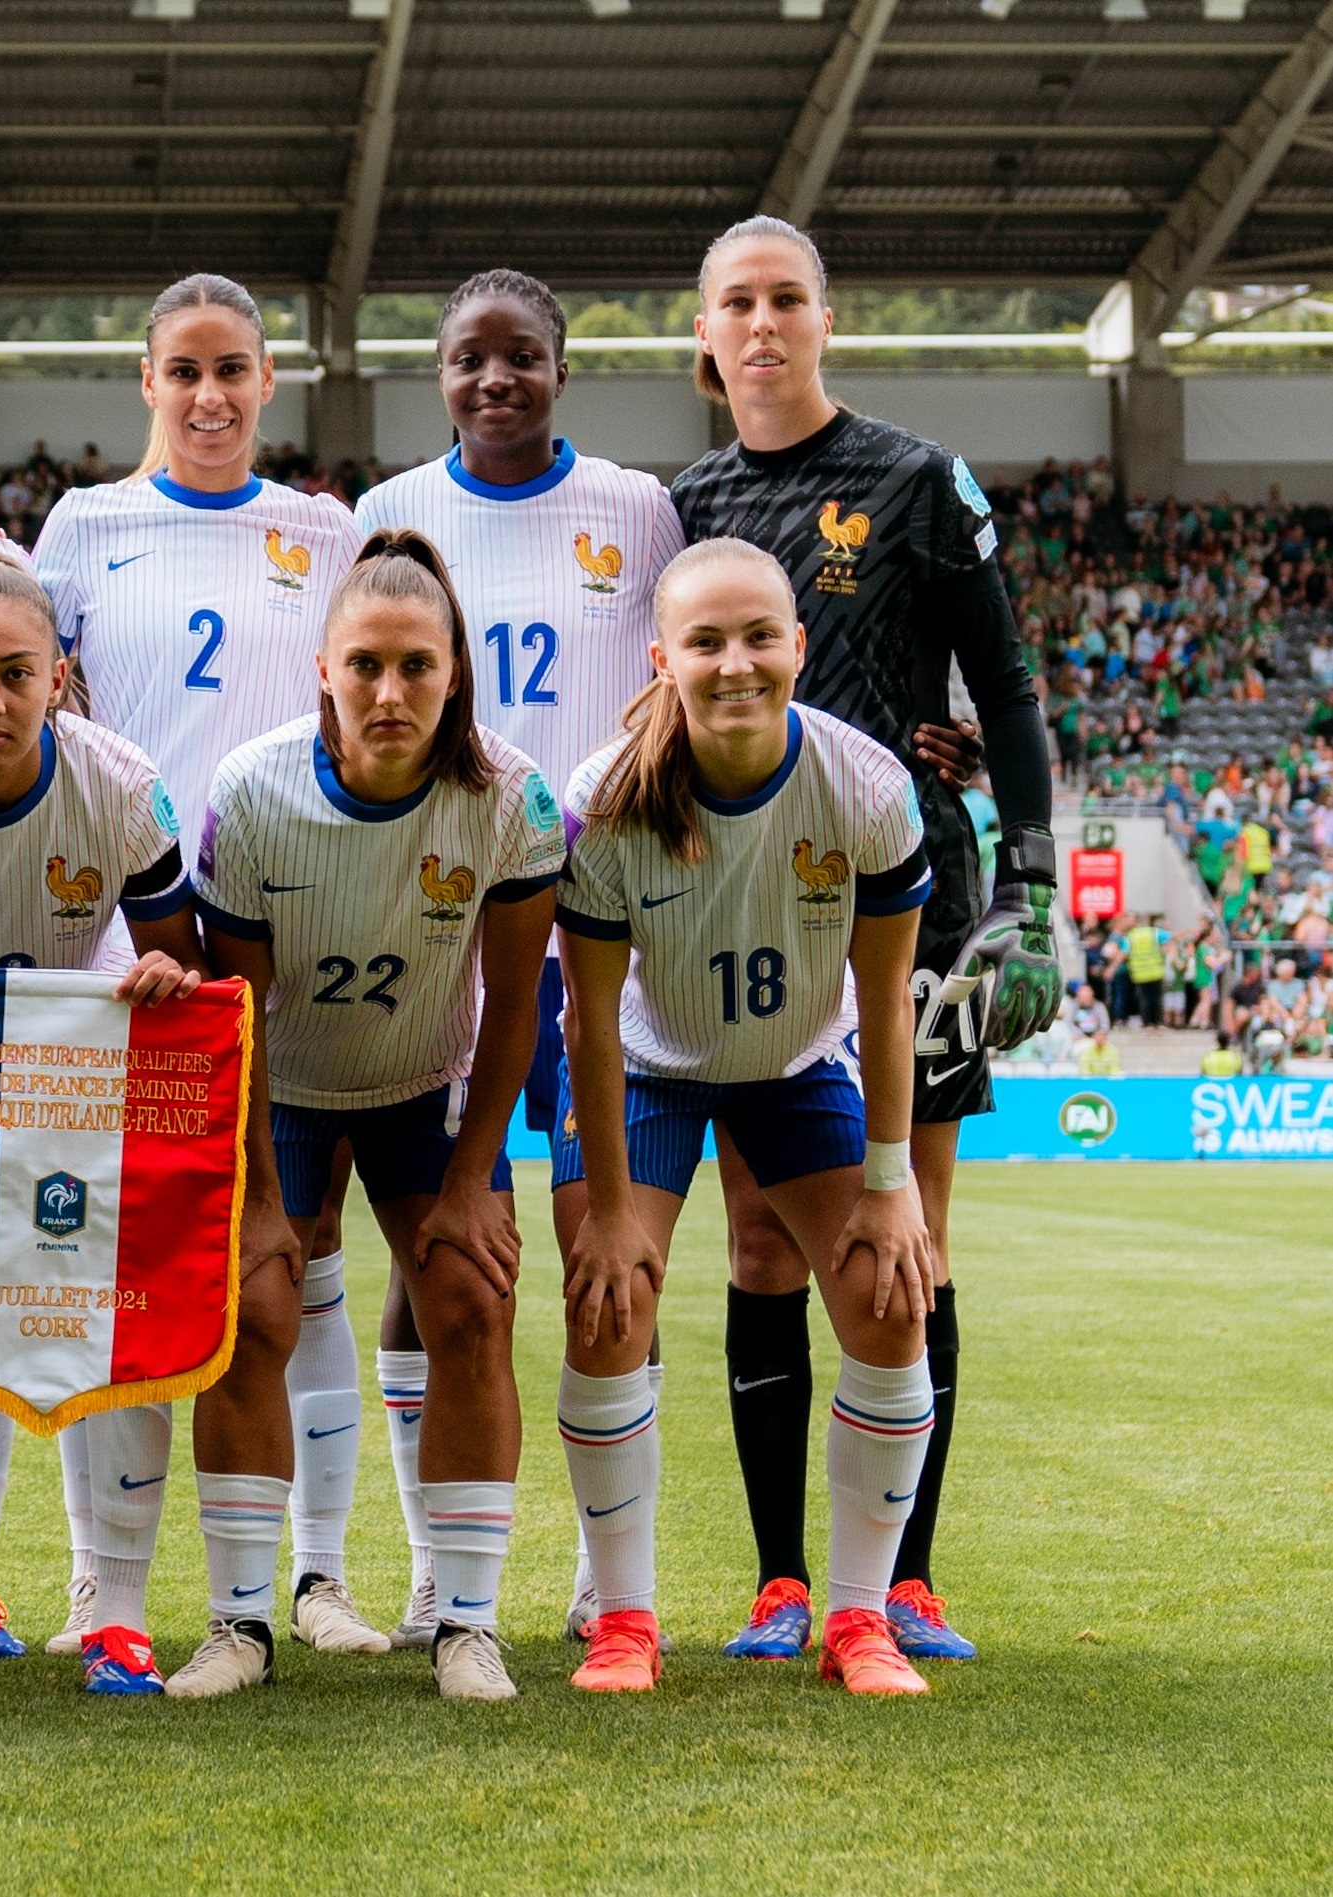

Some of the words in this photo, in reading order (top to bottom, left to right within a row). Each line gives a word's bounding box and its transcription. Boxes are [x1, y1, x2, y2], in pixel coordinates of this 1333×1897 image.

[185, 609, 227, 693] 2
[485, 621, 560, 707] 12
[312, 953, 409, 1015] 22
[709, 946, 787, 1025] 18
[39, 1045, 122, 1068] EUROPEAN
[124, 1049, 212, 1074] QUALIFIERS
[0, 1073, 26, 1093] DE
[28, 1075, 107, 1097] FRANCE
[110, 1077, 208, 1102] FEMININE
[1065, 1104, 1109, 1132] FAI
[41, 1217, 78, 1226] FRANCE
[36, 1242, 79, 1252] FÉMININE
[97, 1290, 148, 1311] 2024
[19, 1315, 88, 1340] CORK
